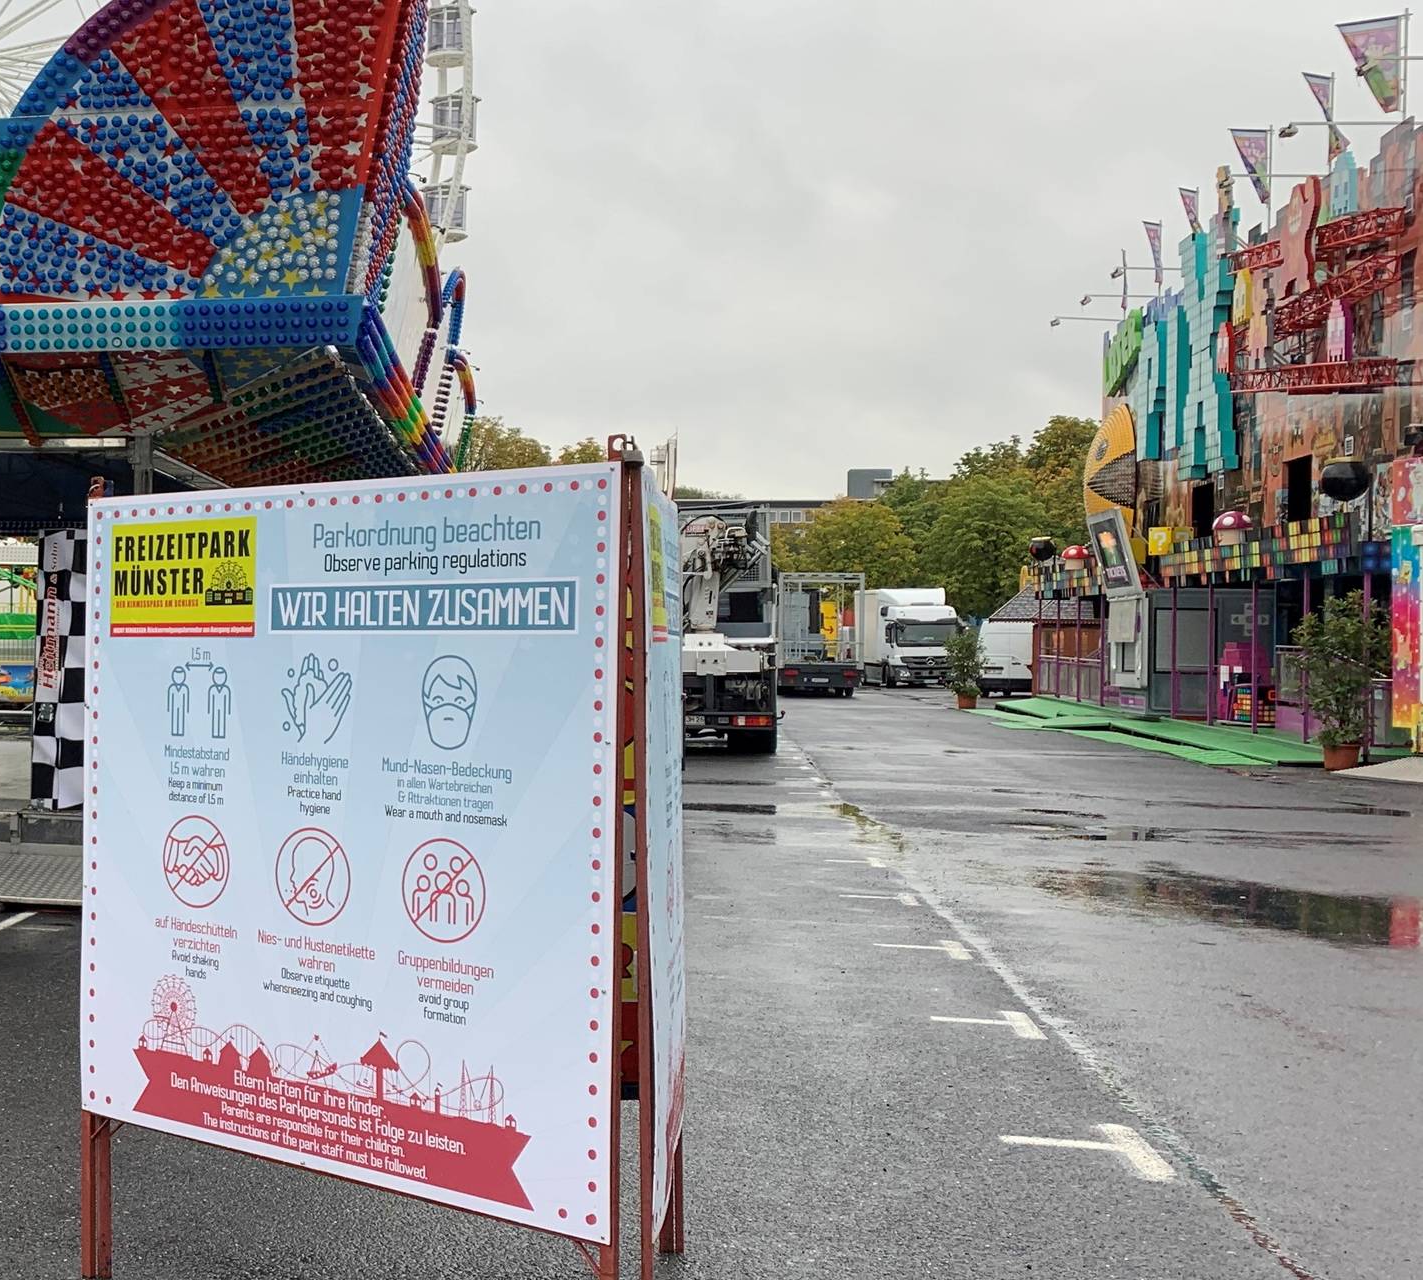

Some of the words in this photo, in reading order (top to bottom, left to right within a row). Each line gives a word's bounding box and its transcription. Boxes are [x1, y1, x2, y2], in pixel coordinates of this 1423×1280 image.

[313, 520, 437, 552] Parkordnung
[443, 514, 541, 544] beachten
[115, 529, 250, 562] FREIZEITPARK
[324, 552, 381, 573] Observe
[384, 551, 439, 576] parking
[442, 549, 527, 575] regulations
[114, 565, 204, 596] MÜNSTER
[277, 591, 327, 626] WIR
[334, 589, 420, 626] HALTEN
[427, 586, 570, 626] ZUSAMMEN
[203, 650, 211, 661] m
[164, 744, 230, 761] Mindestabstand
[281, 751, 349, 772] Händehygiene
[181, 766, 189, 775] m
[191, 764, 226, 778] wahren
[293, 772, 338, 786] einhalten
[381, 757, 513, 784] Mund-Nasen-Bedeckung
[168, 777, 185, 791] Keep
[192, 781, 223, 792] minimum
[287, 786, 320, 800] Practice
[322, 789, 342, 801] hand
[397, 777, 405, 788] in
[406, 777, 426, 789] allen
[168, 791, 197, 803] distance
[198, 793, 207, 804] of
[217, 797, 224, 805] m
[407, 791, 462, 808] Attraktionen
[464, 796, 494, 812] tragen
[300, 803, 331, 816] hygiene
[384, 804, 407, 818] Wear
[416, 809, 443, 821] mouth
[445, 811, 461, 823] and
[463, 813, 508, 827] nosemask
[155, 916, 169, 929] auf
[171, 916, 238, 939] Händeschütteln
[172, 936, 221, 954] verzichten
[257, 929, 282, 945] Nies-
[284, 935, 302, 950] und
[305, 936, 376, 961] Hustenetikette
[172, 950, 190, 964] Avoid
[192, 953, 220, 971] shaking
[298, 955, 336, 973] wahren
[397, 950, 495, 981] Gruppenbildungen
[185, 966, 207, 980] hands
[281, 967, 313, 984] Observe
[315, 973, 350, 990] etiquette
[263, 980, 318, 1002] whensneezing
[319, 988, 334, 1002] and
[336, 990, 373, 1012] coughing
[416, 976, 474, 995] vermeiden
[418, 993, 442, 1005] avoid
[443, 997, 470, 1013] group
[423, 1006, 467, 1025] formation
[233, 1069, 265, 1092] Eltern
[266, 1076, 302, 1099] haften
[304, 1085, 321, 1103] für
[323, 1089, 346, 1109] ihre
[347, 1094, 387, 1118] Kinder.
[170, 1072, 189, 1090] Den
[190, 1076, 257, 1107] Anweisungen
[258, 1093, 278, 1111] des
[279, 1096, 357, 1129] Parkpersonals
[359, 1116, 373, 1133] ist
[375, 1118, 405, 1144] Folge
[407, 1129, 423, 1146] zu
[425, 1130, 467, 1155] leisten.
[221, 1101, 255, 1121] Parents
[256, 1111, 271, 1124] are
[272, 1116, 323, 1137] responsible
[325, 1125, 339, 1141] for
[340, 1130, 363, 1147] their
[365, 1136, 406, 1158] children.
[202, 1111, 218, 1128] The
[219, 1116, 270, 1141] instructions
[270, 1127, 281, 1143] of
[282, 1131, 298, 1148] the
[298, 1137, 320, 1153] park
[321, 1140, 345, 1159] staff
[345, 1148, 369, 1166] must
[370, 1153, 383, 1169] be
[384, 1158, 429, 1180] followed.
